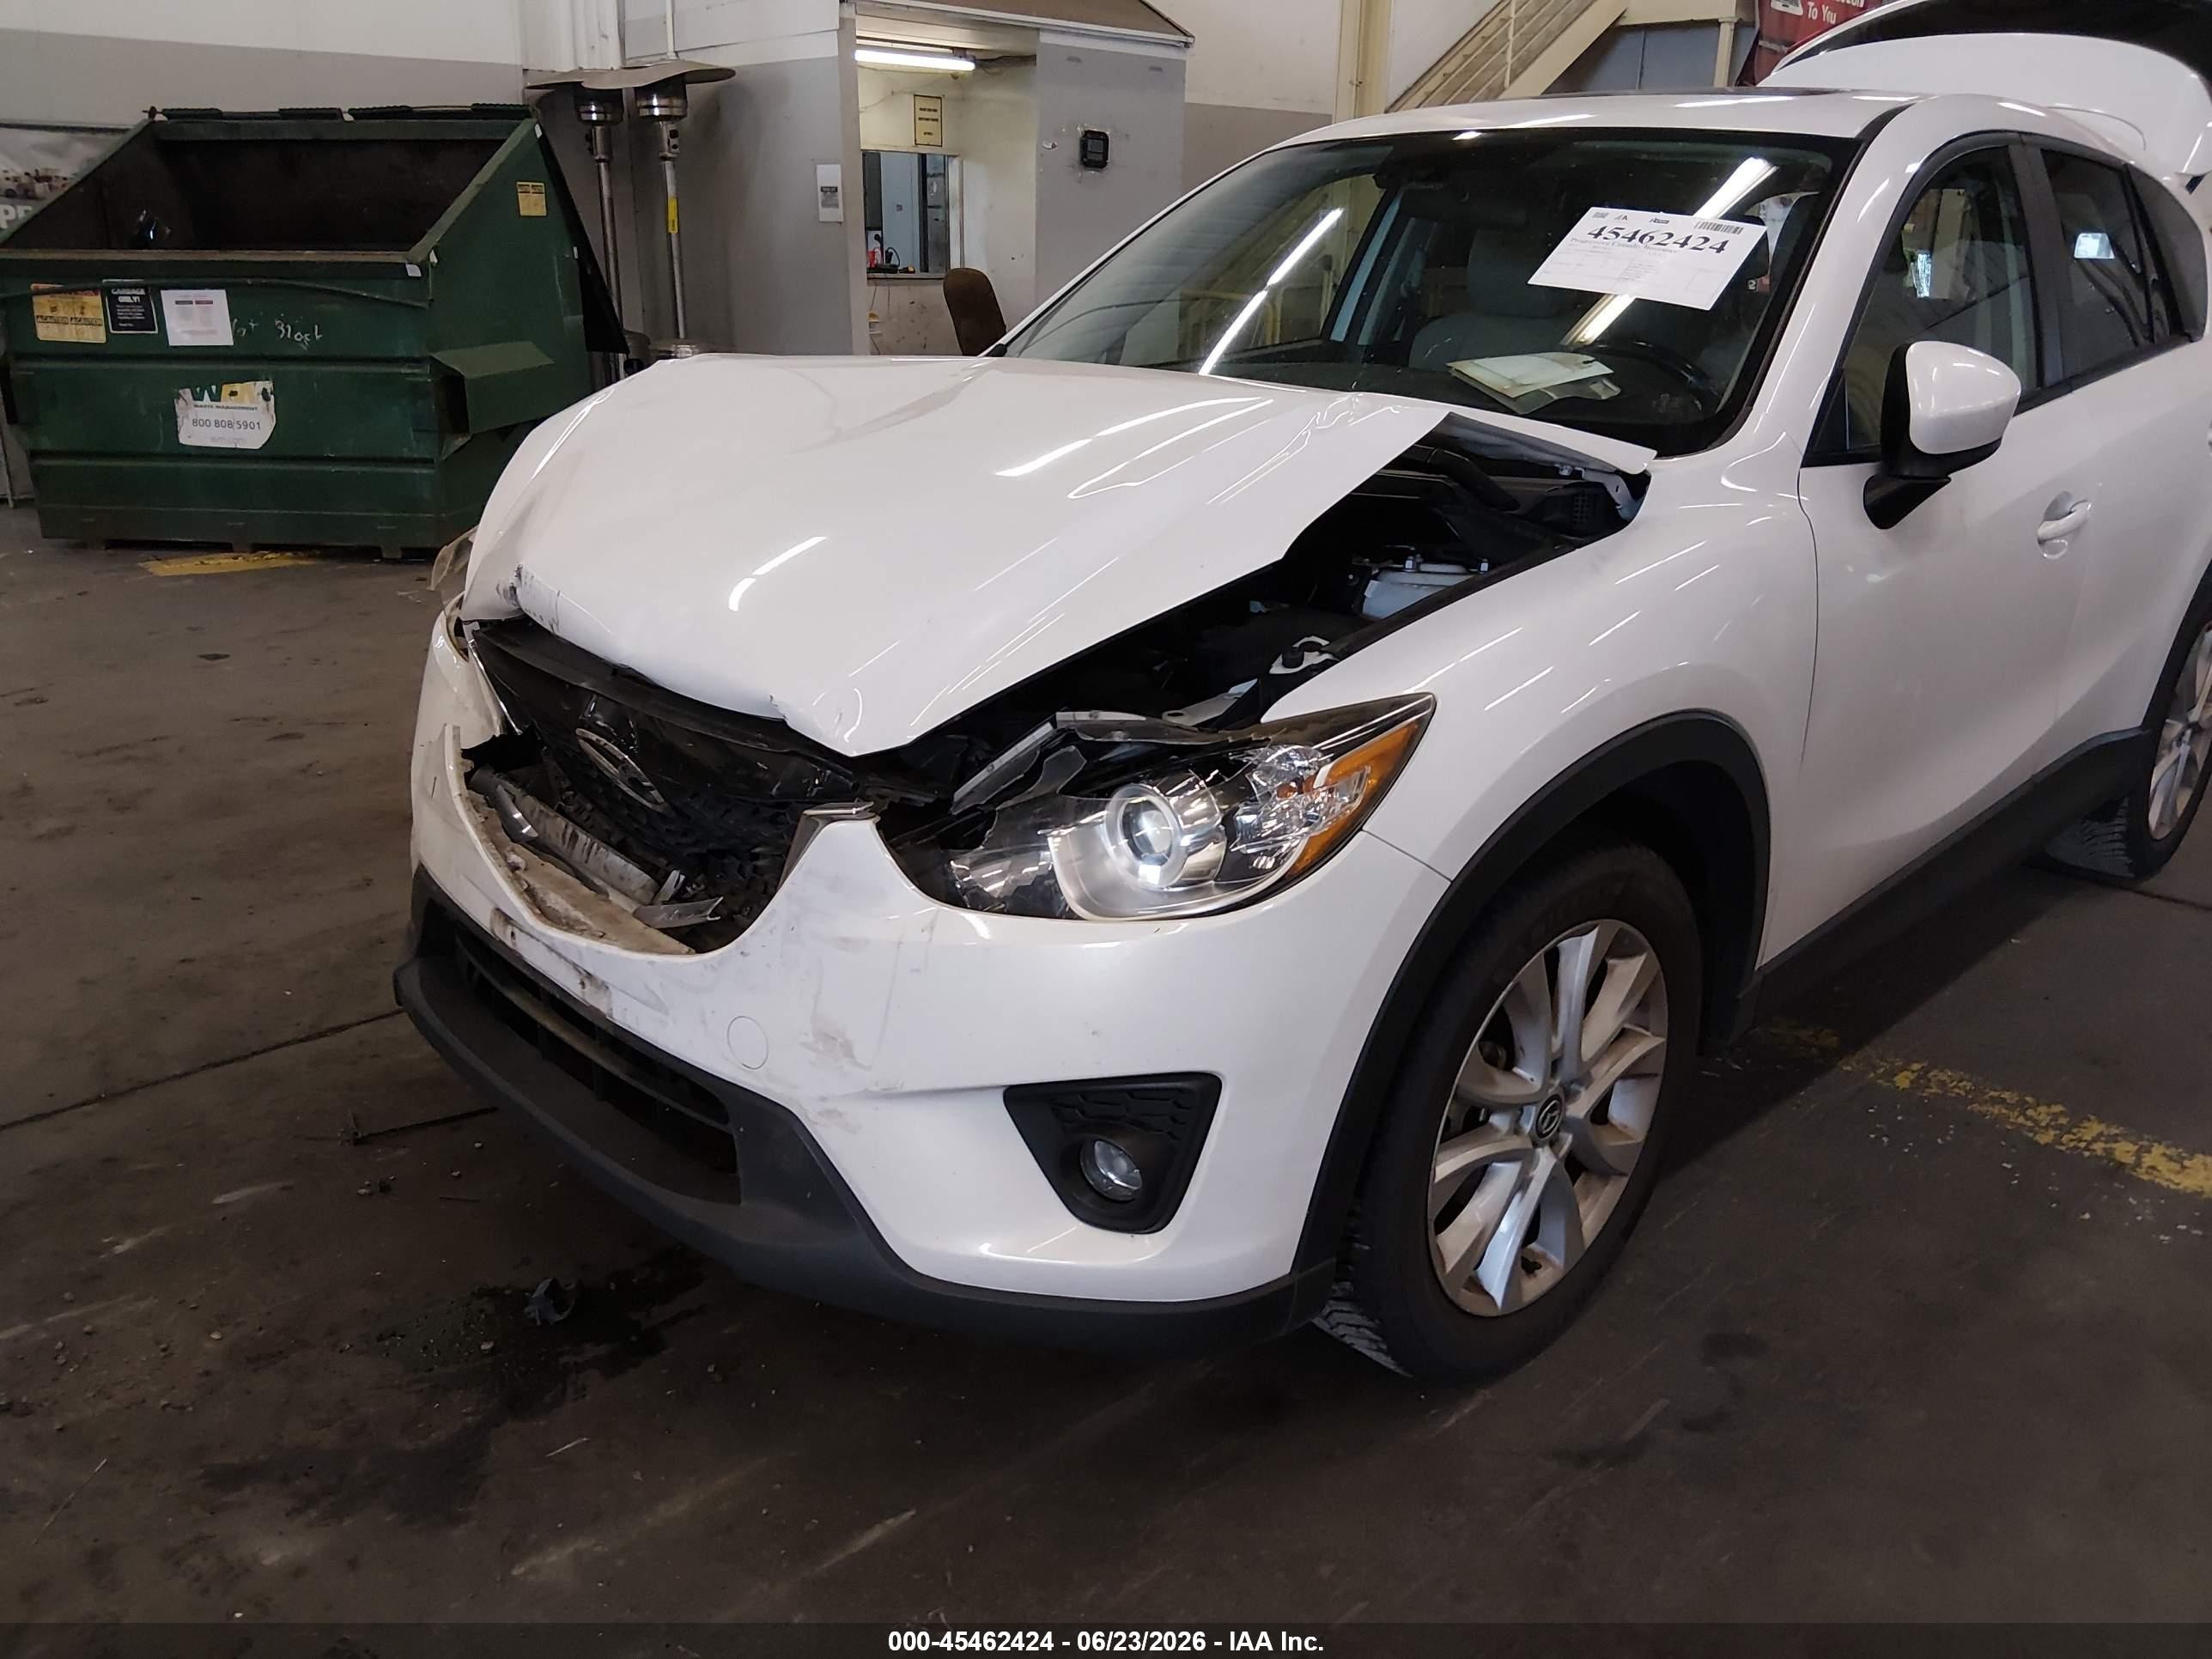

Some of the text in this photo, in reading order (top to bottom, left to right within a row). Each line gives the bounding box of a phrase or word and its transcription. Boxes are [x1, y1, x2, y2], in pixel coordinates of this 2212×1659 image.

[1808, 1, 1837, 25] To You
[1587, 225, 1730, 254] 45462424
[191, 418, 261, 430] 800 808 5901
